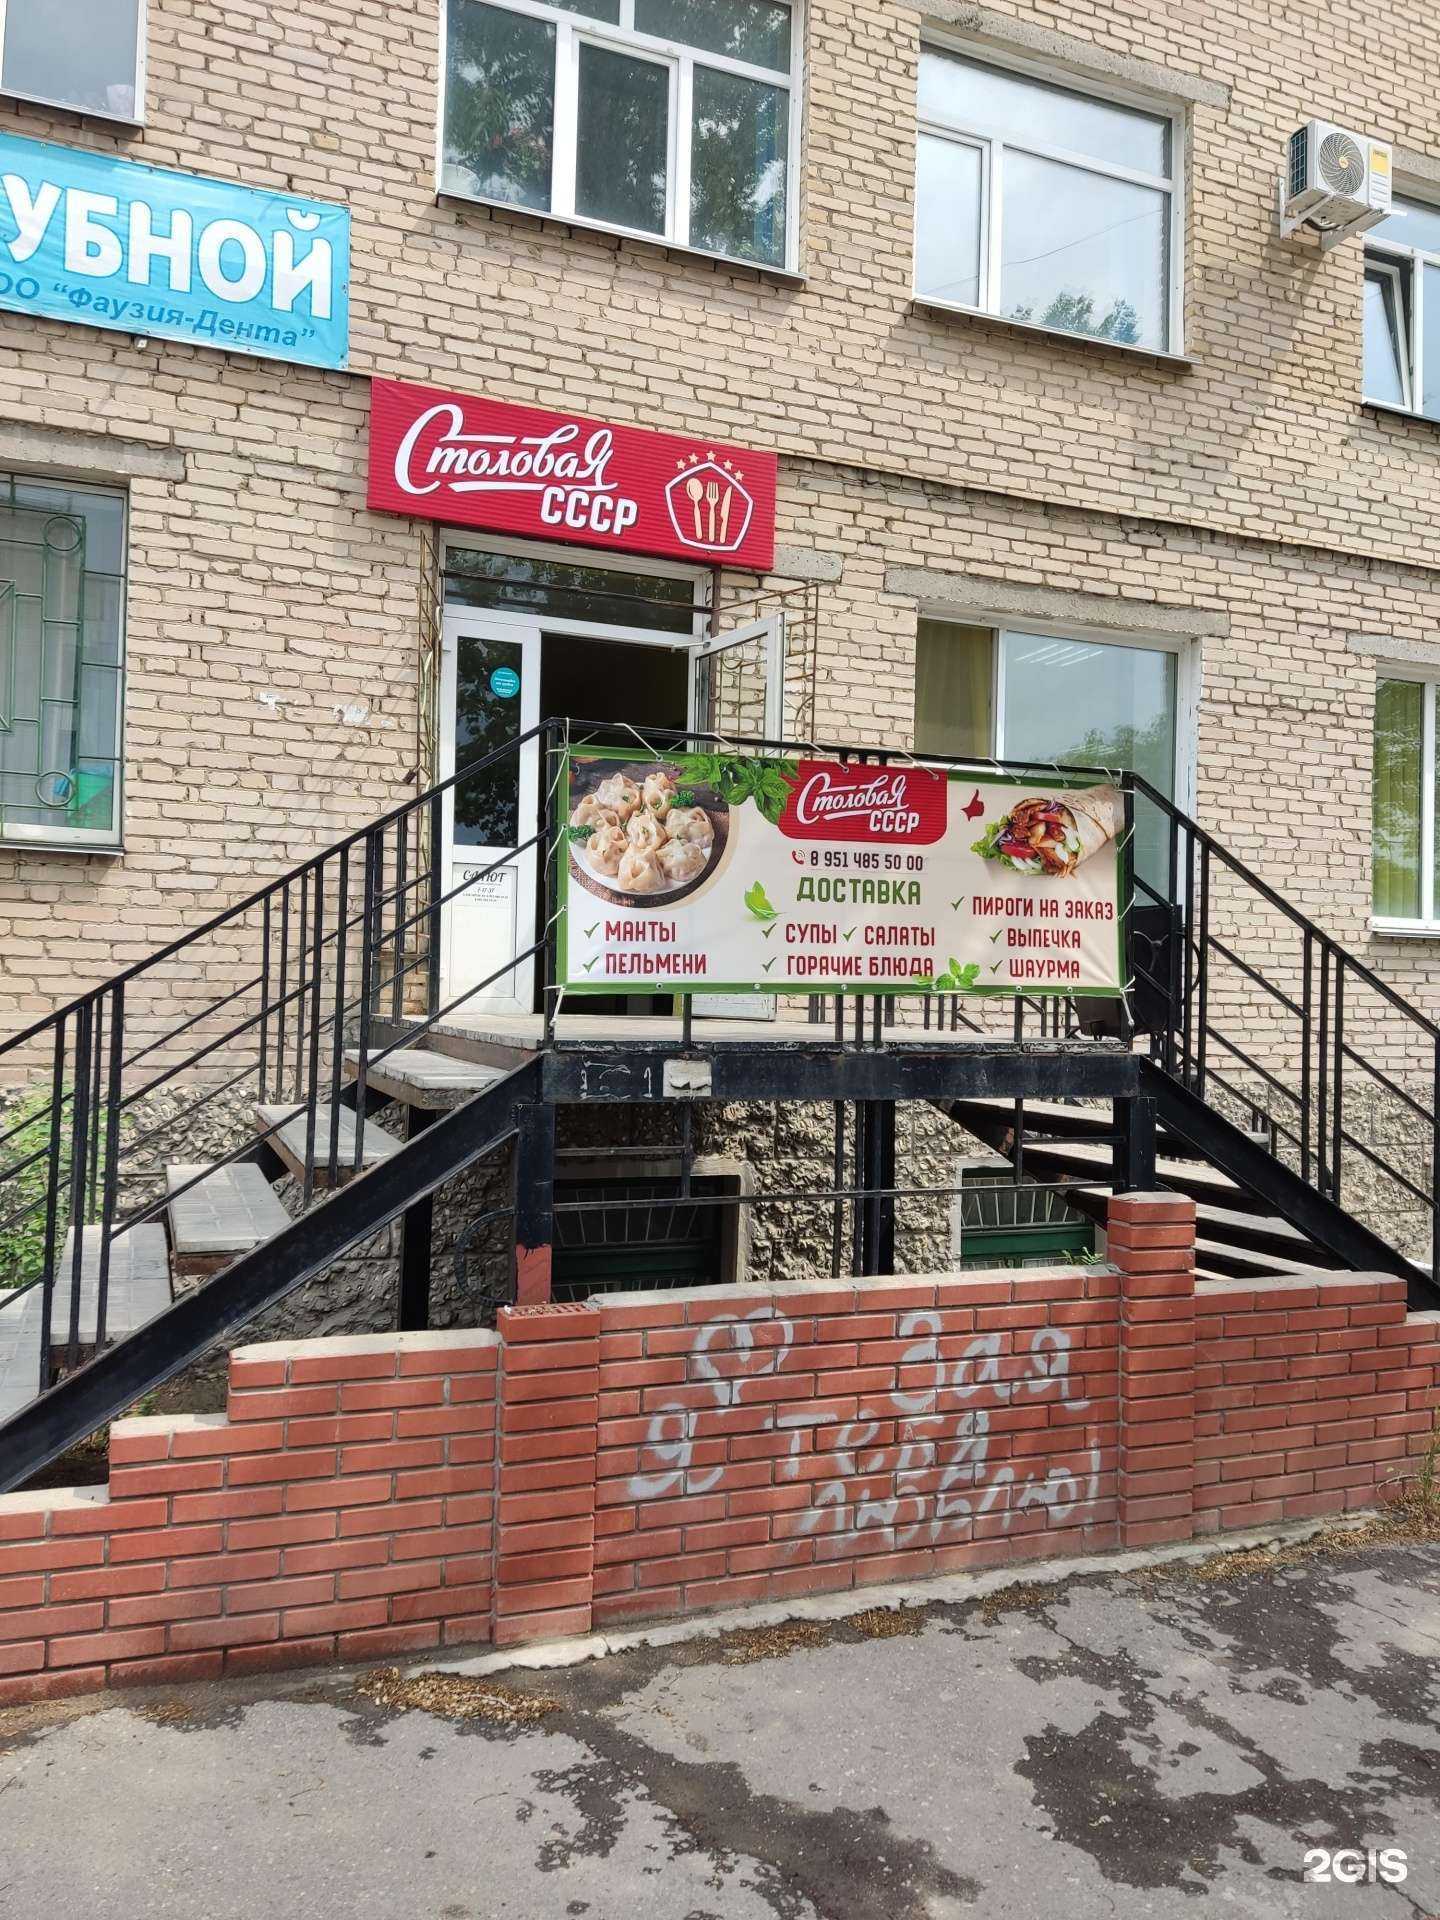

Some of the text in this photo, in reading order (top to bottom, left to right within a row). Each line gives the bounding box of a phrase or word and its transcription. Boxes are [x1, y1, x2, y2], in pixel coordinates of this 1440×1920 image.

[1, 173, 333, 320] УБНОЙ
[540, 486, 638, 535] СССР
[869, 810, 920, 834] СССР
[810, 850, 923, 871] 8 951 485 50 00
[796, 876, 921, 905] ДОСТАВКА
[972, 896, 1113, 921] ПИРОГИ НА ЗАКАЗ
[605, 920, 676, 942] МАНТЫ
[785, 923, 935, 946] СУПЫ САЛАТЫ
[1007, 927, 1081, 949] ВЫПЕЧКА
[605, 953, 707, 975] ПЕЛЬМЕНИ
[787, 956, 934, 977] ГОРЯЧИЕ БЛЮДА
[1009, 958, 1080, 979] ШАУРМА
